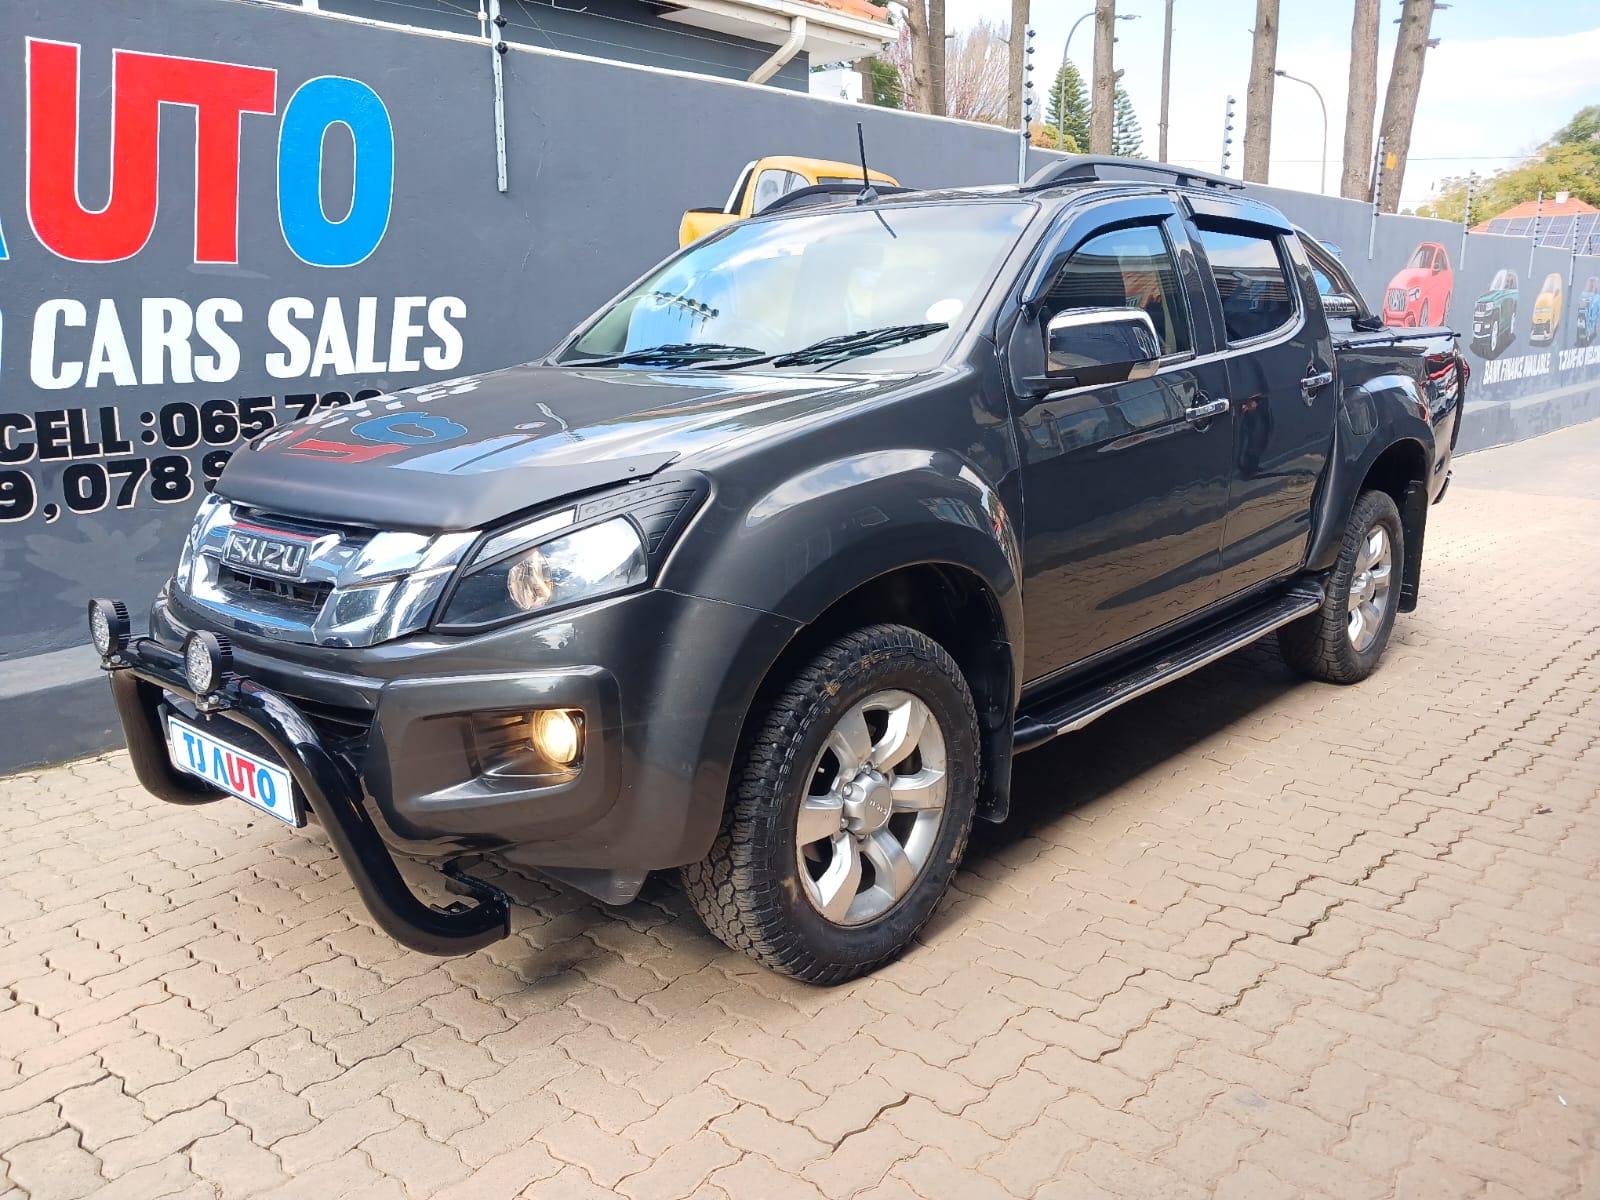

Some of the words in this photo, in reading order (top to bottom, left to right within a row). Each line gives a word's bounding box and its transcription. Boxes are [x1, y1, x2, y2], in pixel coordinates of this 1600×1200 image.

[0, 37, 394, 268] UTO
[30, 297, 243, 390] CARS
[265, 296, 467, 379] SALES
[0, 407, 134, 466] CELL
[225, 534, 305, 573] ISUZU
[183, 731, 206, 773] TJ
[213, 747, 276, 808] AUTO
